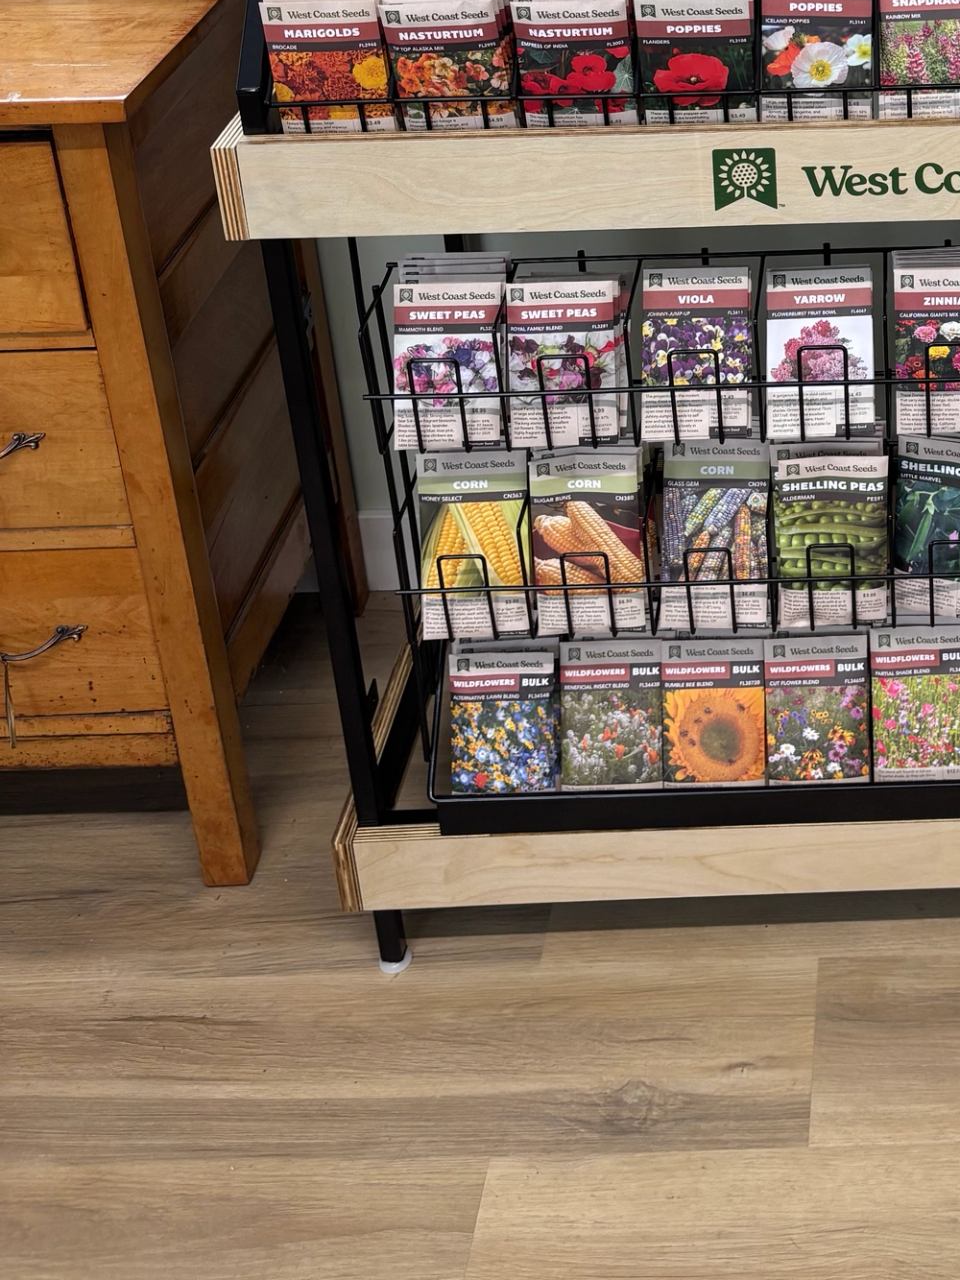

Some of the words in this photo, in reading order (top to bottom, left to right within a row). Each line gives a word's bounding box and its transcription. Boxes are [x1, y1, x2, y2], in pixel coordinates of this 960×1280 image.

[661, 8, 685, 16] West
[686, 8, 714, 16] Coast
[716, 7, 743, 15] Seeds
[790, 3, 843, 12] POPPIES
[284, 28, 360, 38] MARIGOLDS
[529, 27, 613, 37] NASTURTIUM
[666, 25, 722, 33] POPPIES
[399, 28, 483, 40] NASTURTIUM
[801, 165, 908, 197] West
[678, 295, 714, 304] VIOLA
[794, 294, 845, 304] YARROW
[521, 309, 564, 319] SWEET
[566, 308, 597, 317] PEAS
[700, 466, 734, 475] CORN
[453, 480, 488, 490] CORN
[568, 480, 601, 488] CORN
[782, 480, 847, 492] SHELLING
[850, 482, 884, 491] PEAS
[665, 666, 726, 674] WILDFLOWERS
[733, 665, 760, 674] BULK
[454, 679, 515, 687] WILDFLOWERS
[522, 678, 549, 686] BULK
